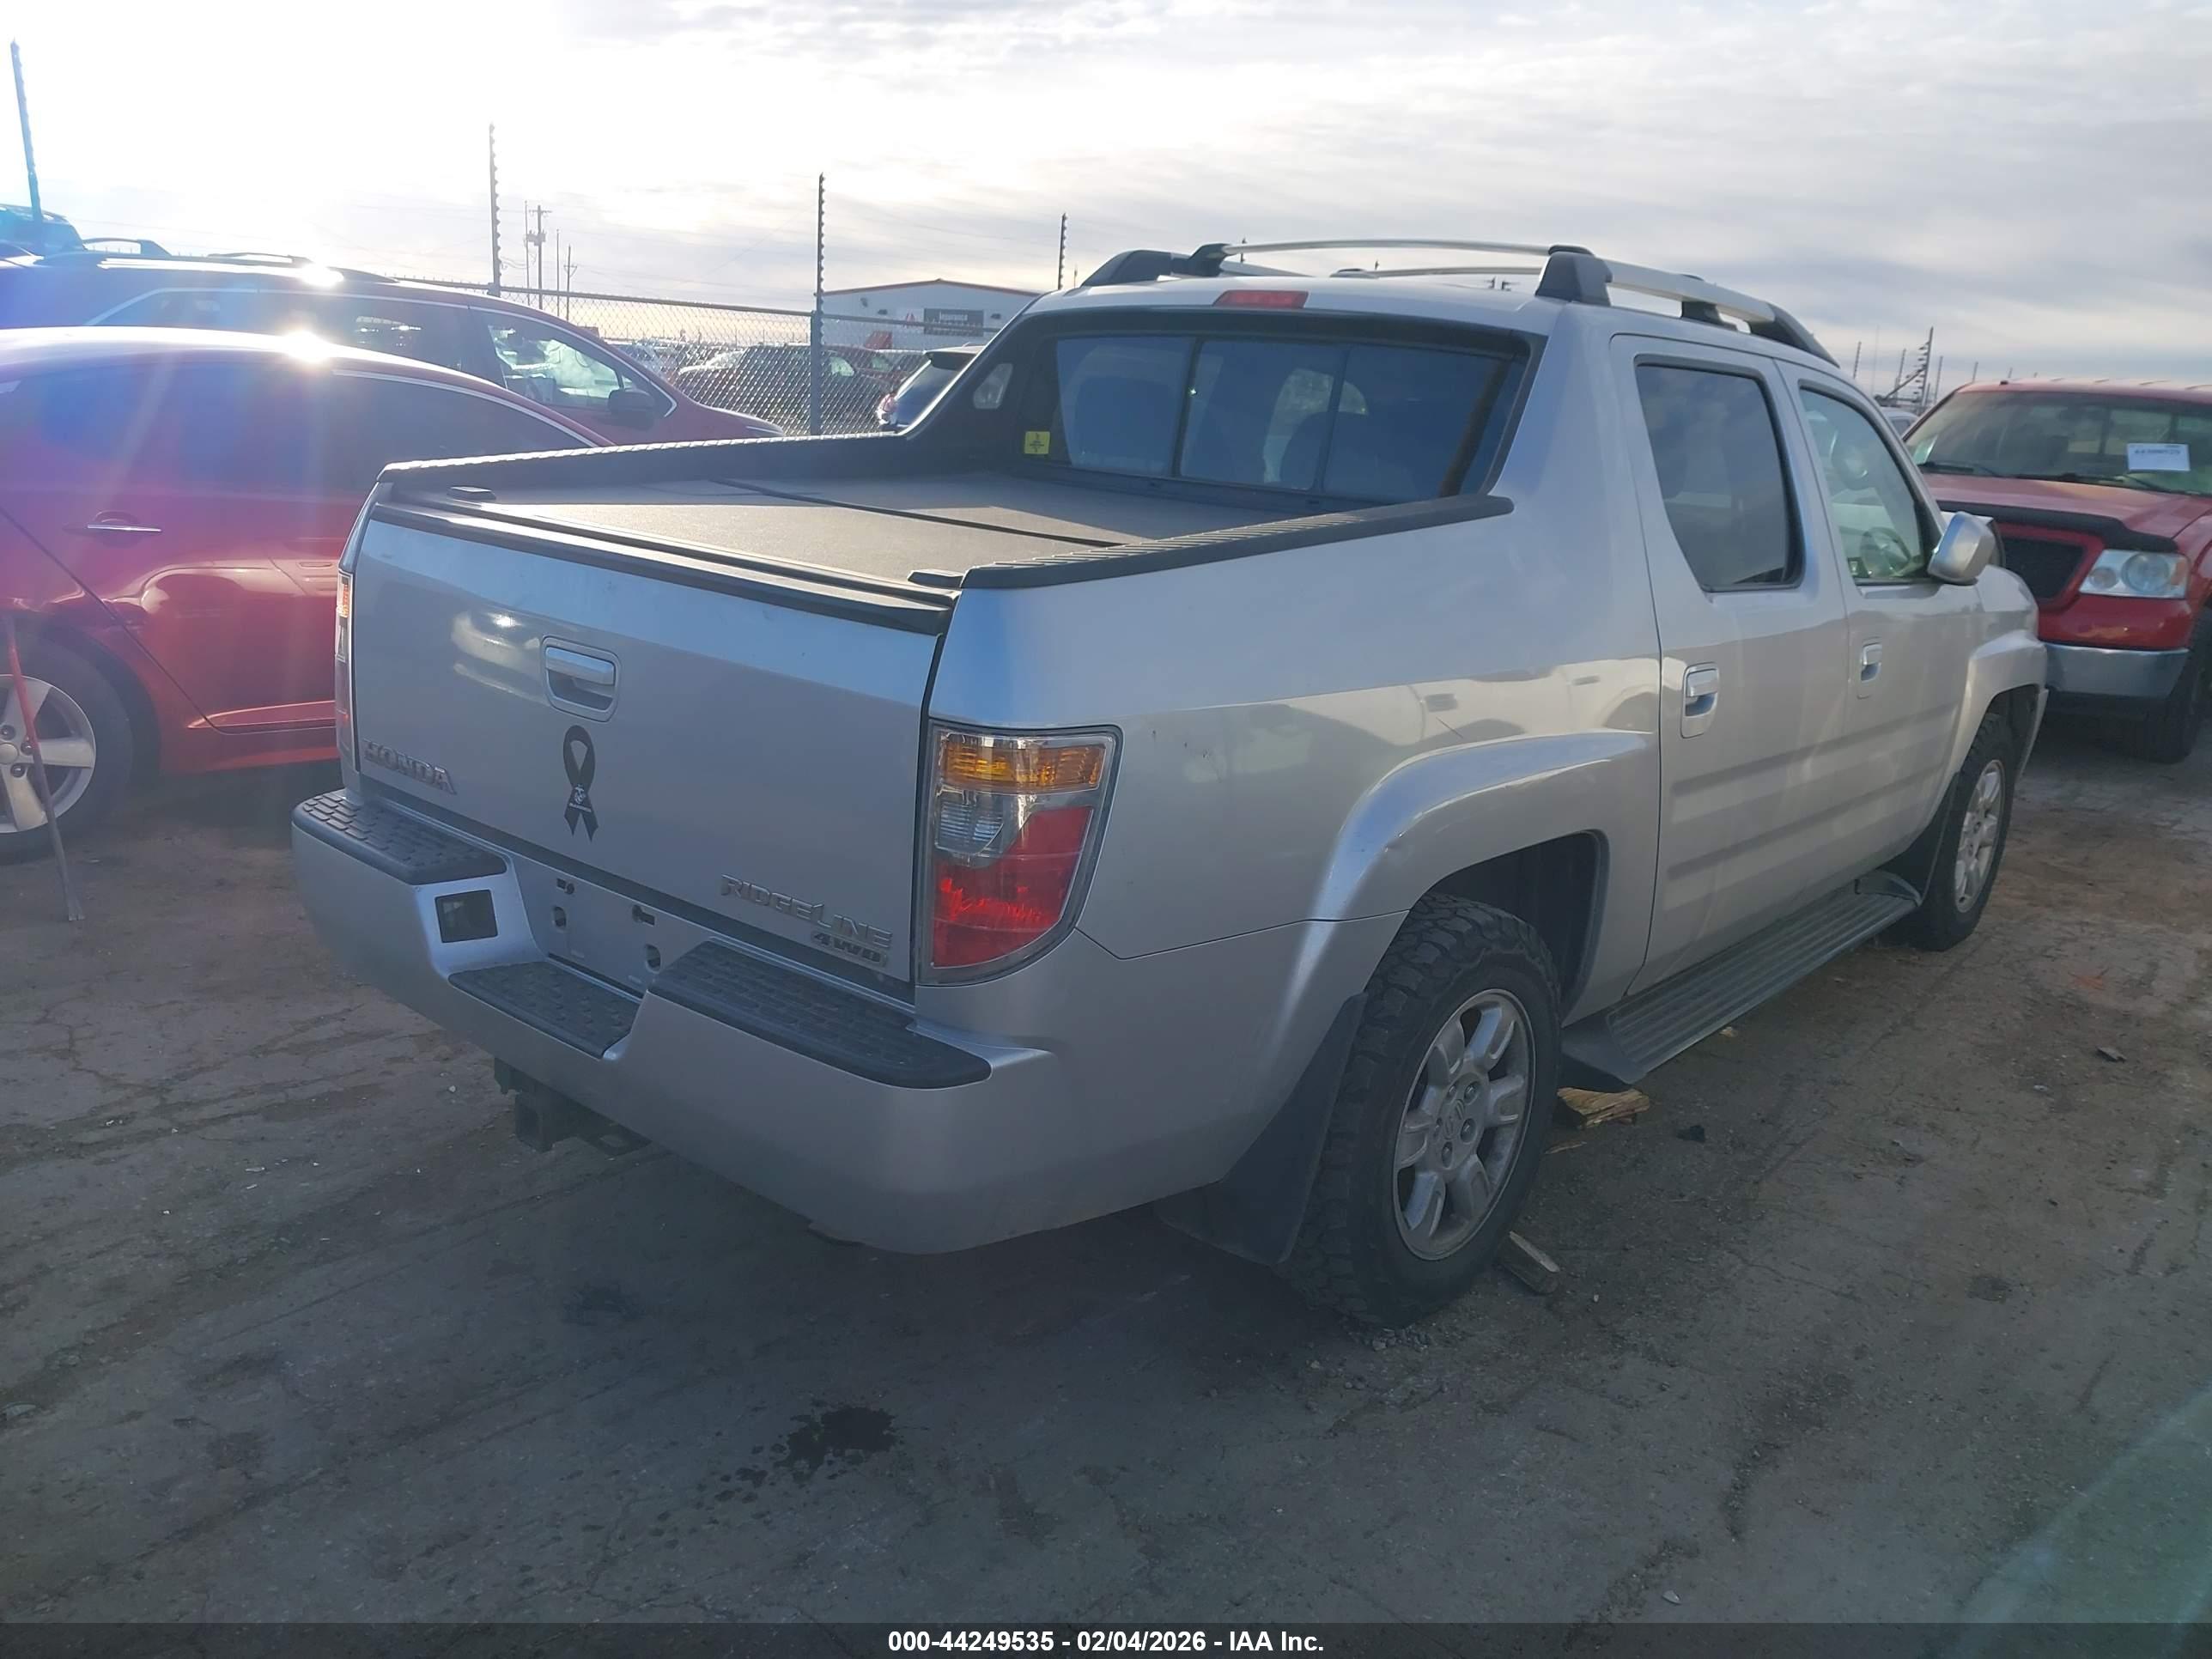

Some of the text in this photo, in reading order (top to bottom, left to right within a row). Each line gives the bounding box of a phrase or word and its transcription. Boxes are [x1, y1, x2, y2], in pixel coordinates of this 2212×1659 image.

[362, 738, 458, 795] HONDA
[720, 873, 893, 949] RIDGELINE
[812, 931, 883, 963] 4WD
